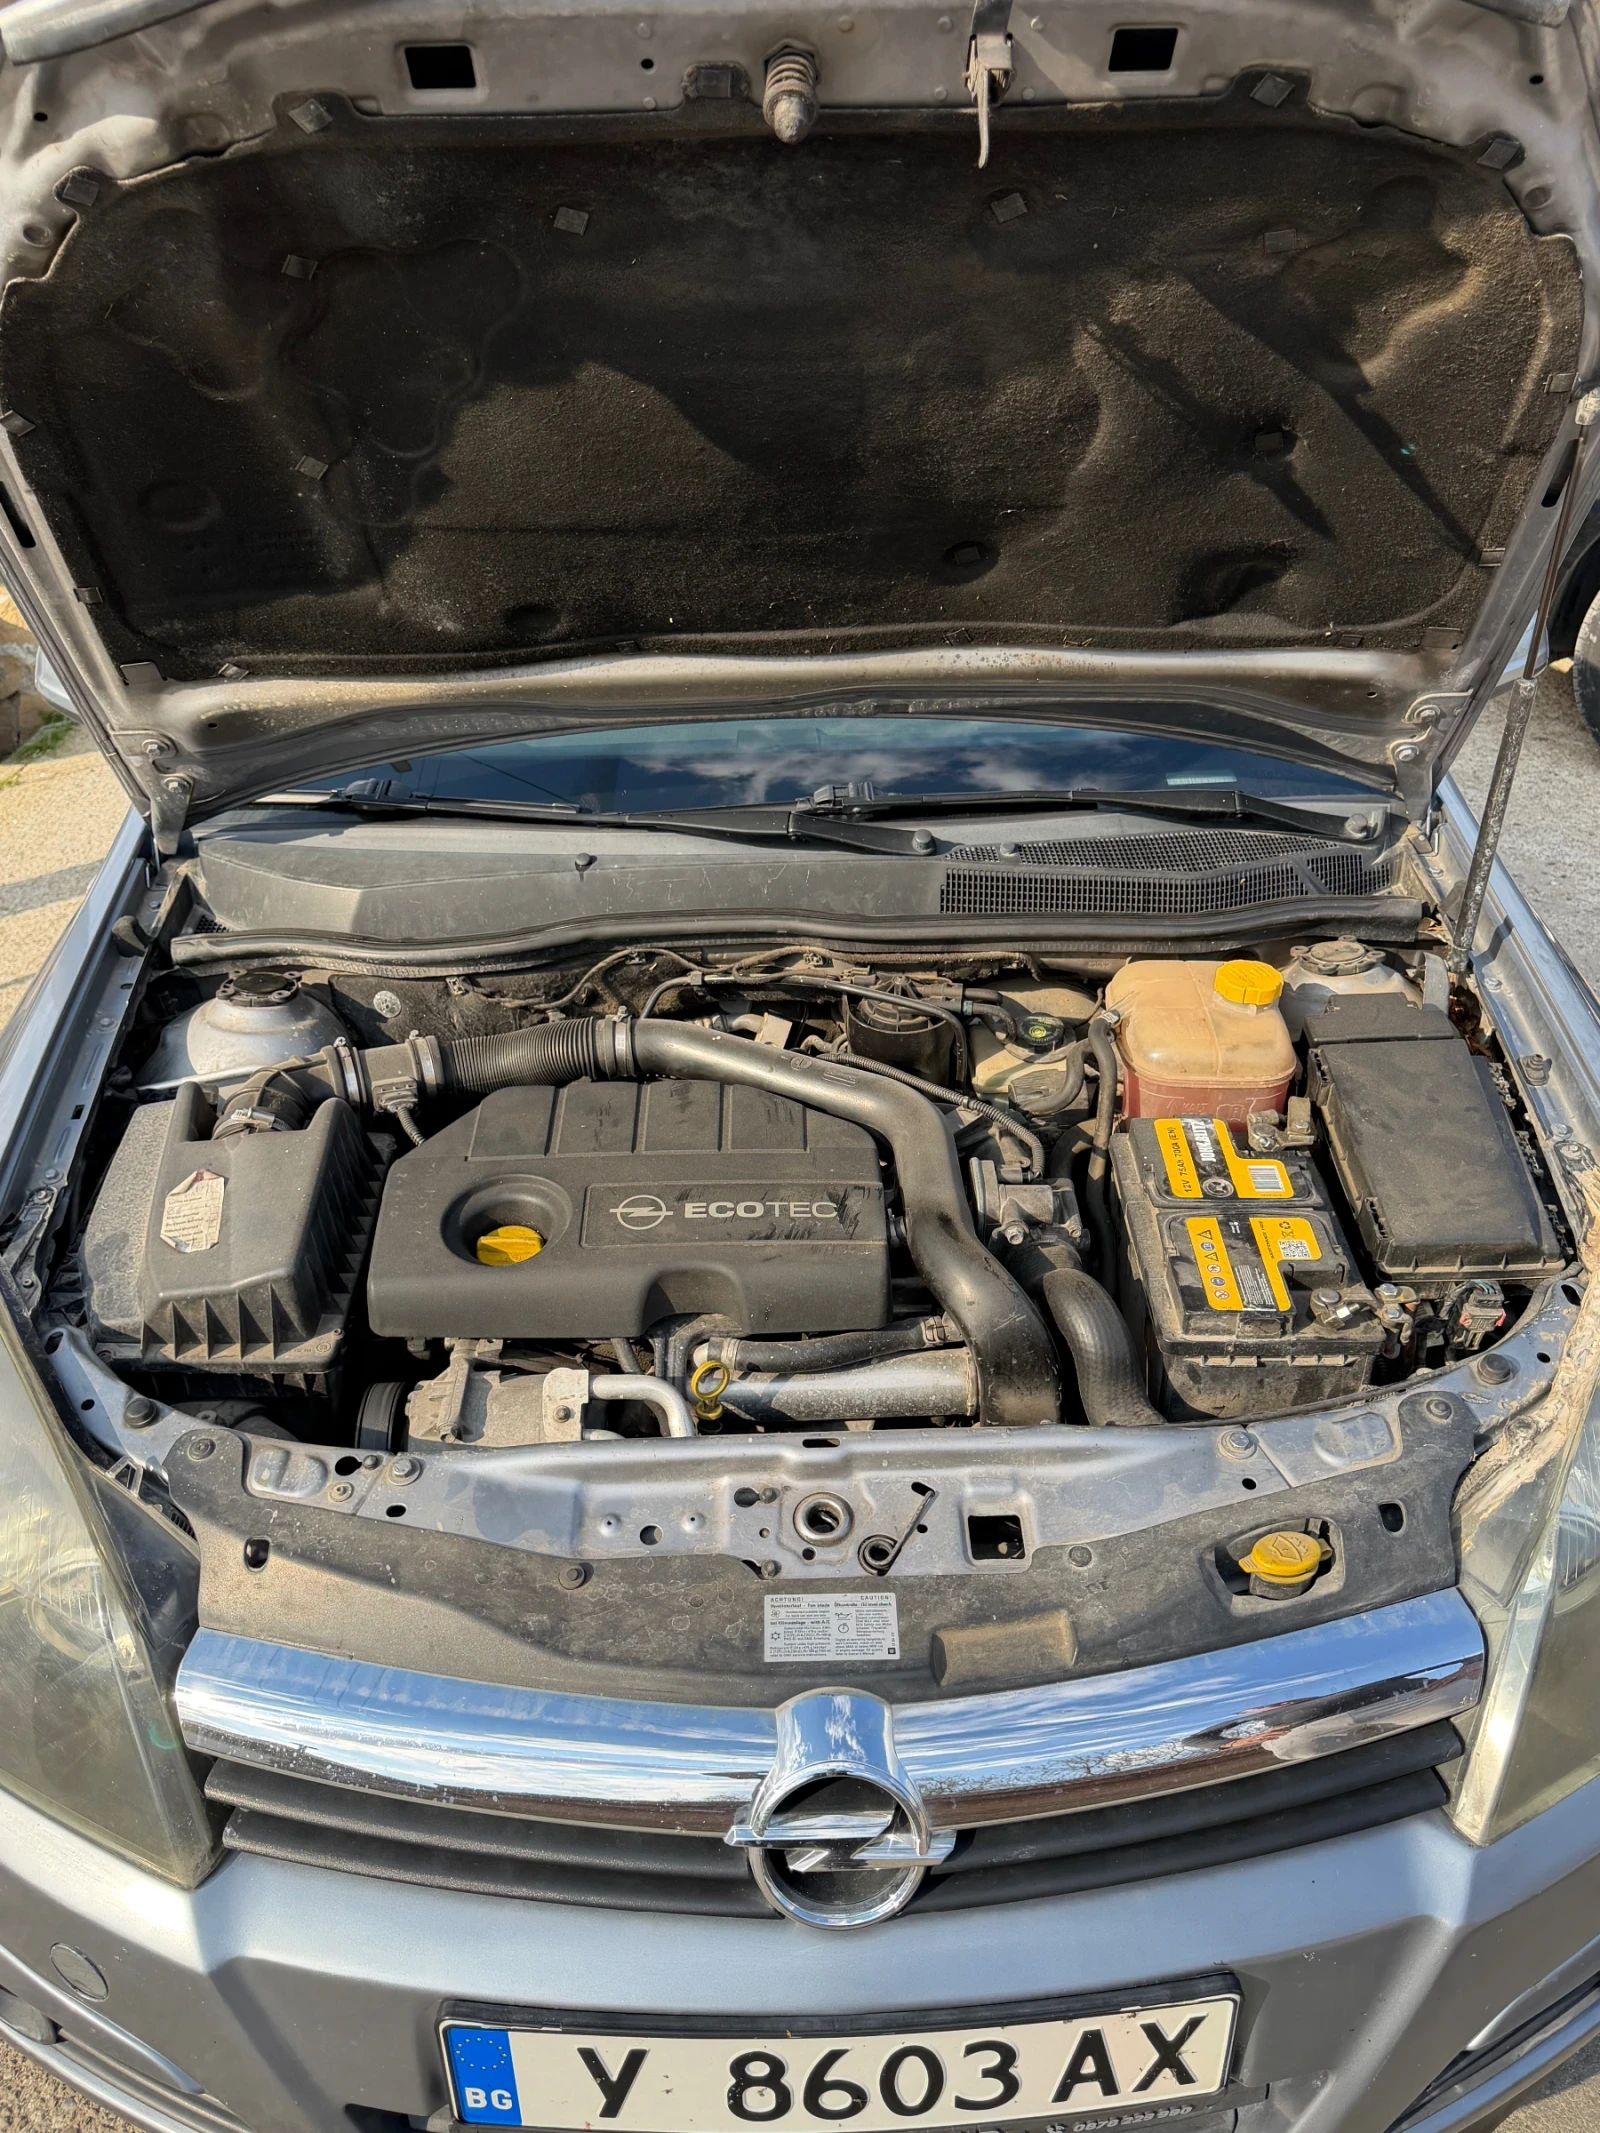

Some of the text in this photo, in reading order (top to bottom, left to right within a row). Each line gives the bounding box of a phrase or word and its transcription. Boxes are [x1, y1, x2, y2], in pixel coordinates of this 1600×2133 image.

[1166, 1127, 1193, 1193] 12V 75Ah 700A (EN)
[684, 1201, 838, 1219] ECOTEC
[576, 2014, 1208, 2122] Y 8603 AX
[464, 2087, 513, 2110] BG
